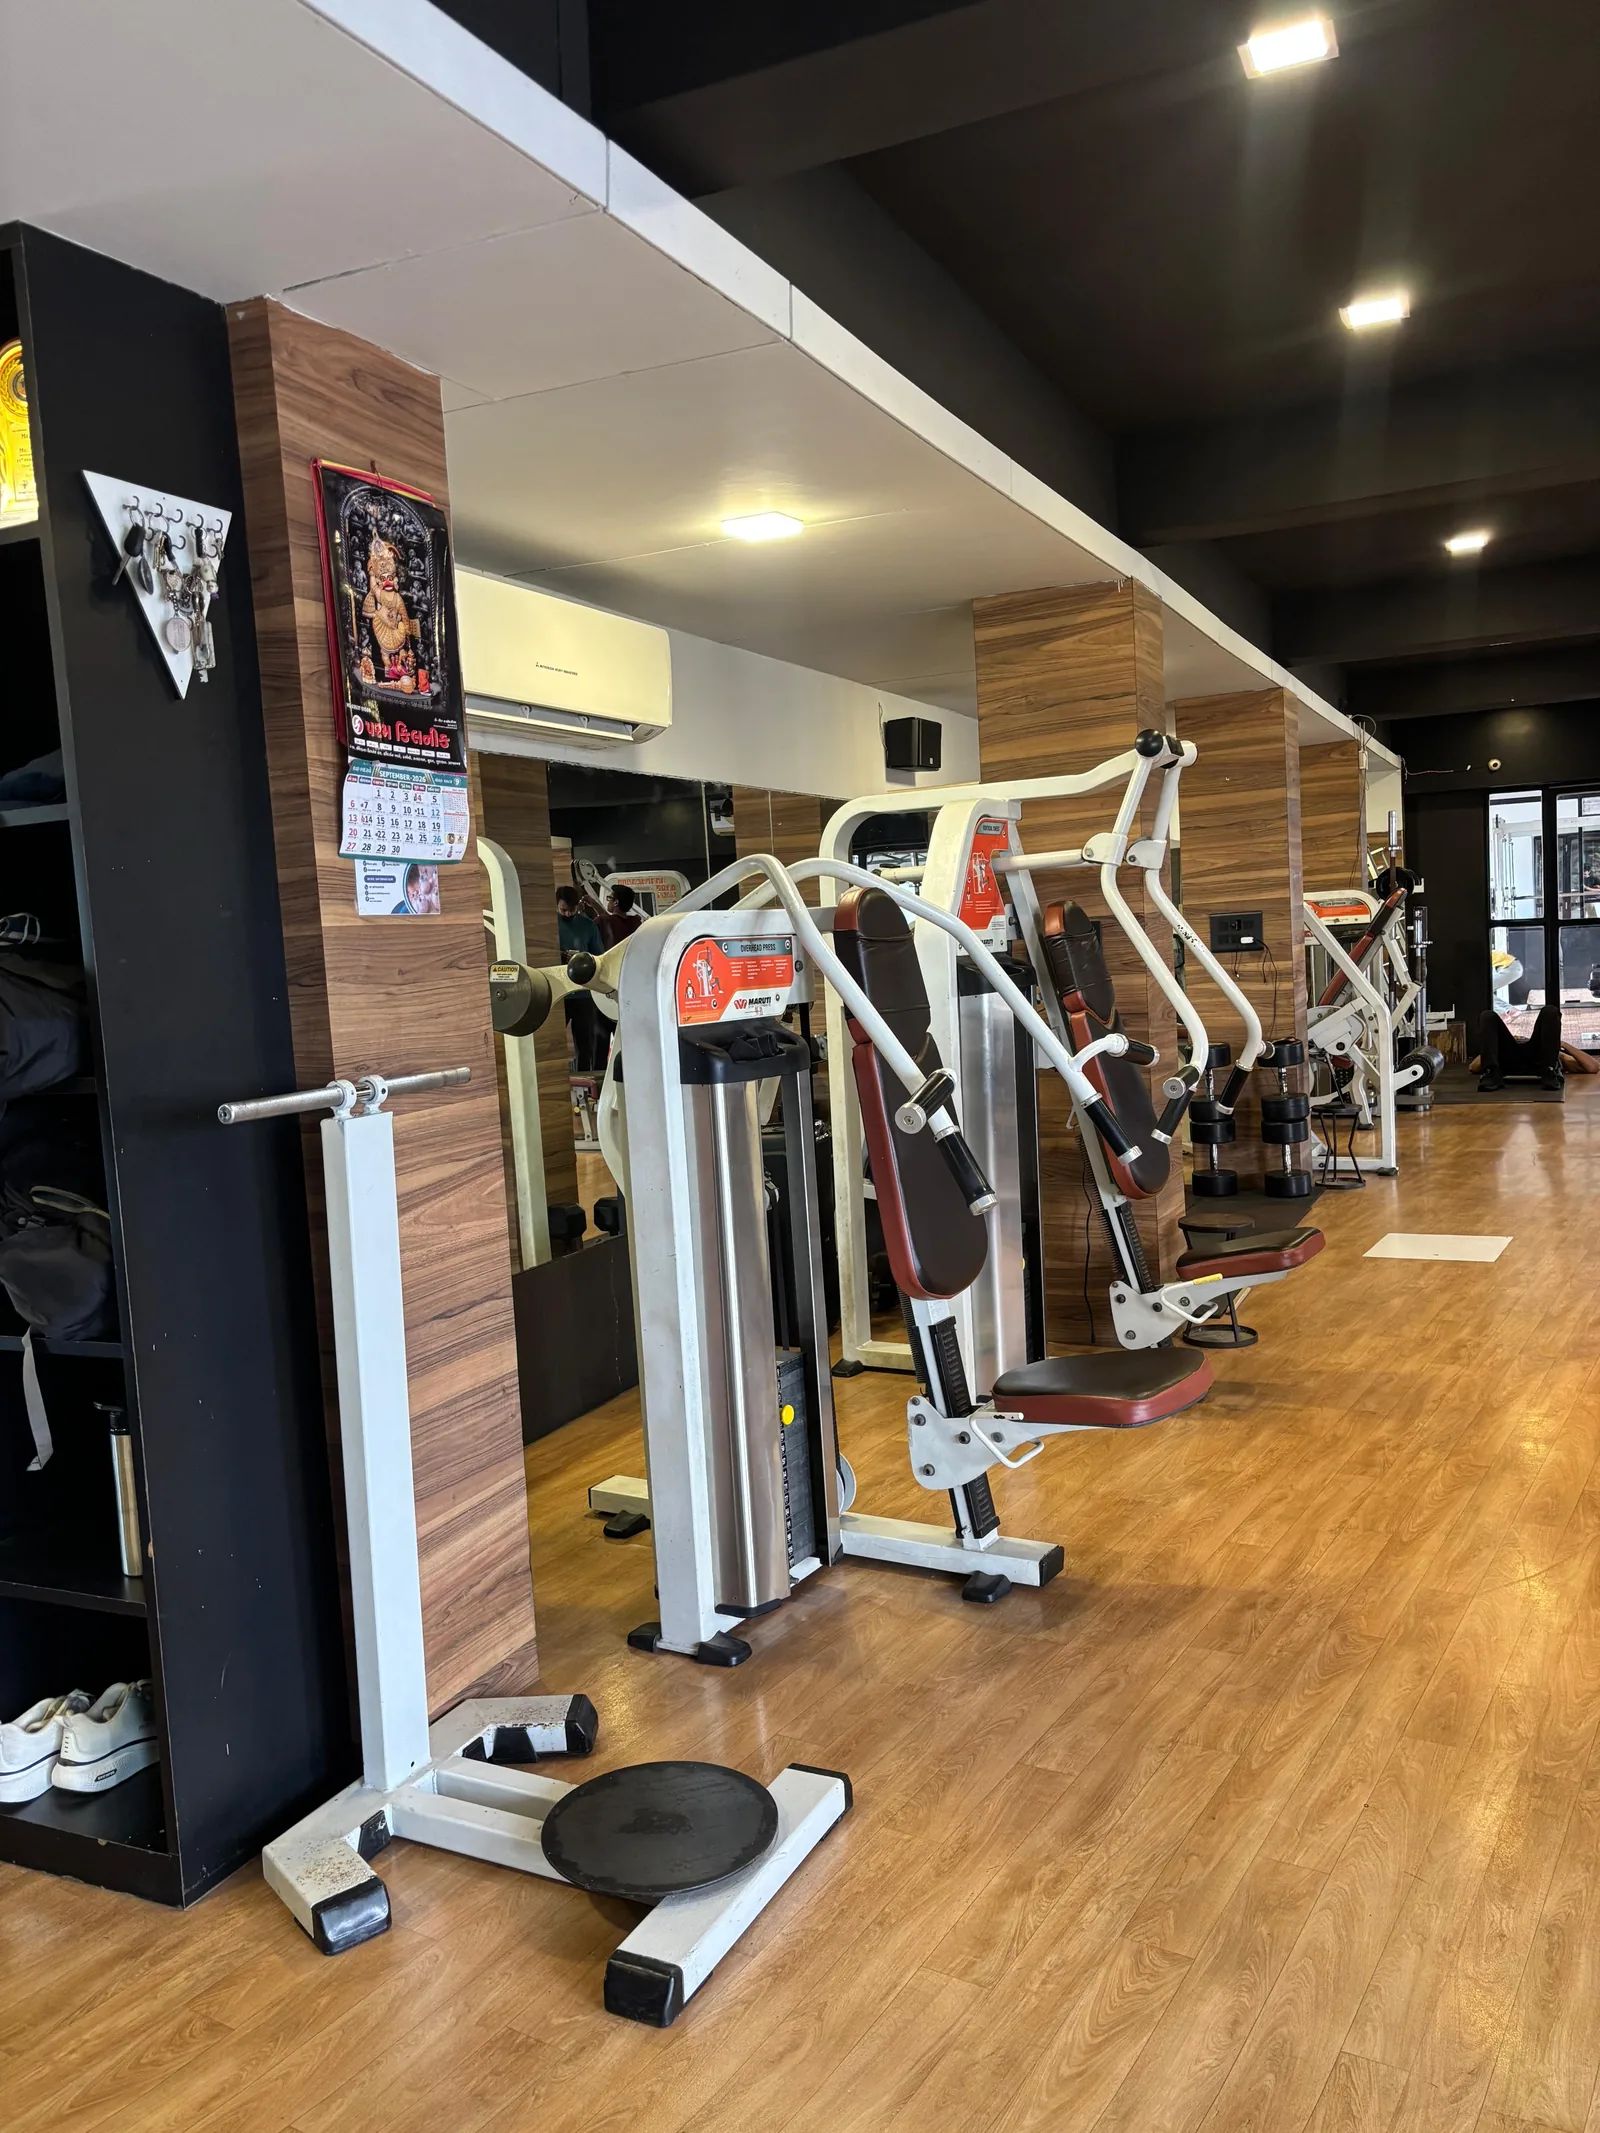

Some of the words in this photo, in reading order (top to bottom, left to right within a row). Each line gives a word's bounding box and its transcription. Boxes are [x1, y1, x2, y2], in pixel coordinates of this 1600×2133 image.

[380, 770, 426, 783] SEPTEMBER-2026
[404, 806, 411, 814] 10
[417, 807, 424, 815] 11
[391, 818, 399, 826] 16
[349, 828, 357, 836] 20
[364, 829, 372, 837] 21
[405, 833, 413, 841] 24
[377, 844, 386, 852] 29
[741, 944, 762, 952] OVERHEAD
[748, 997, 771, 1005] MARUTI
